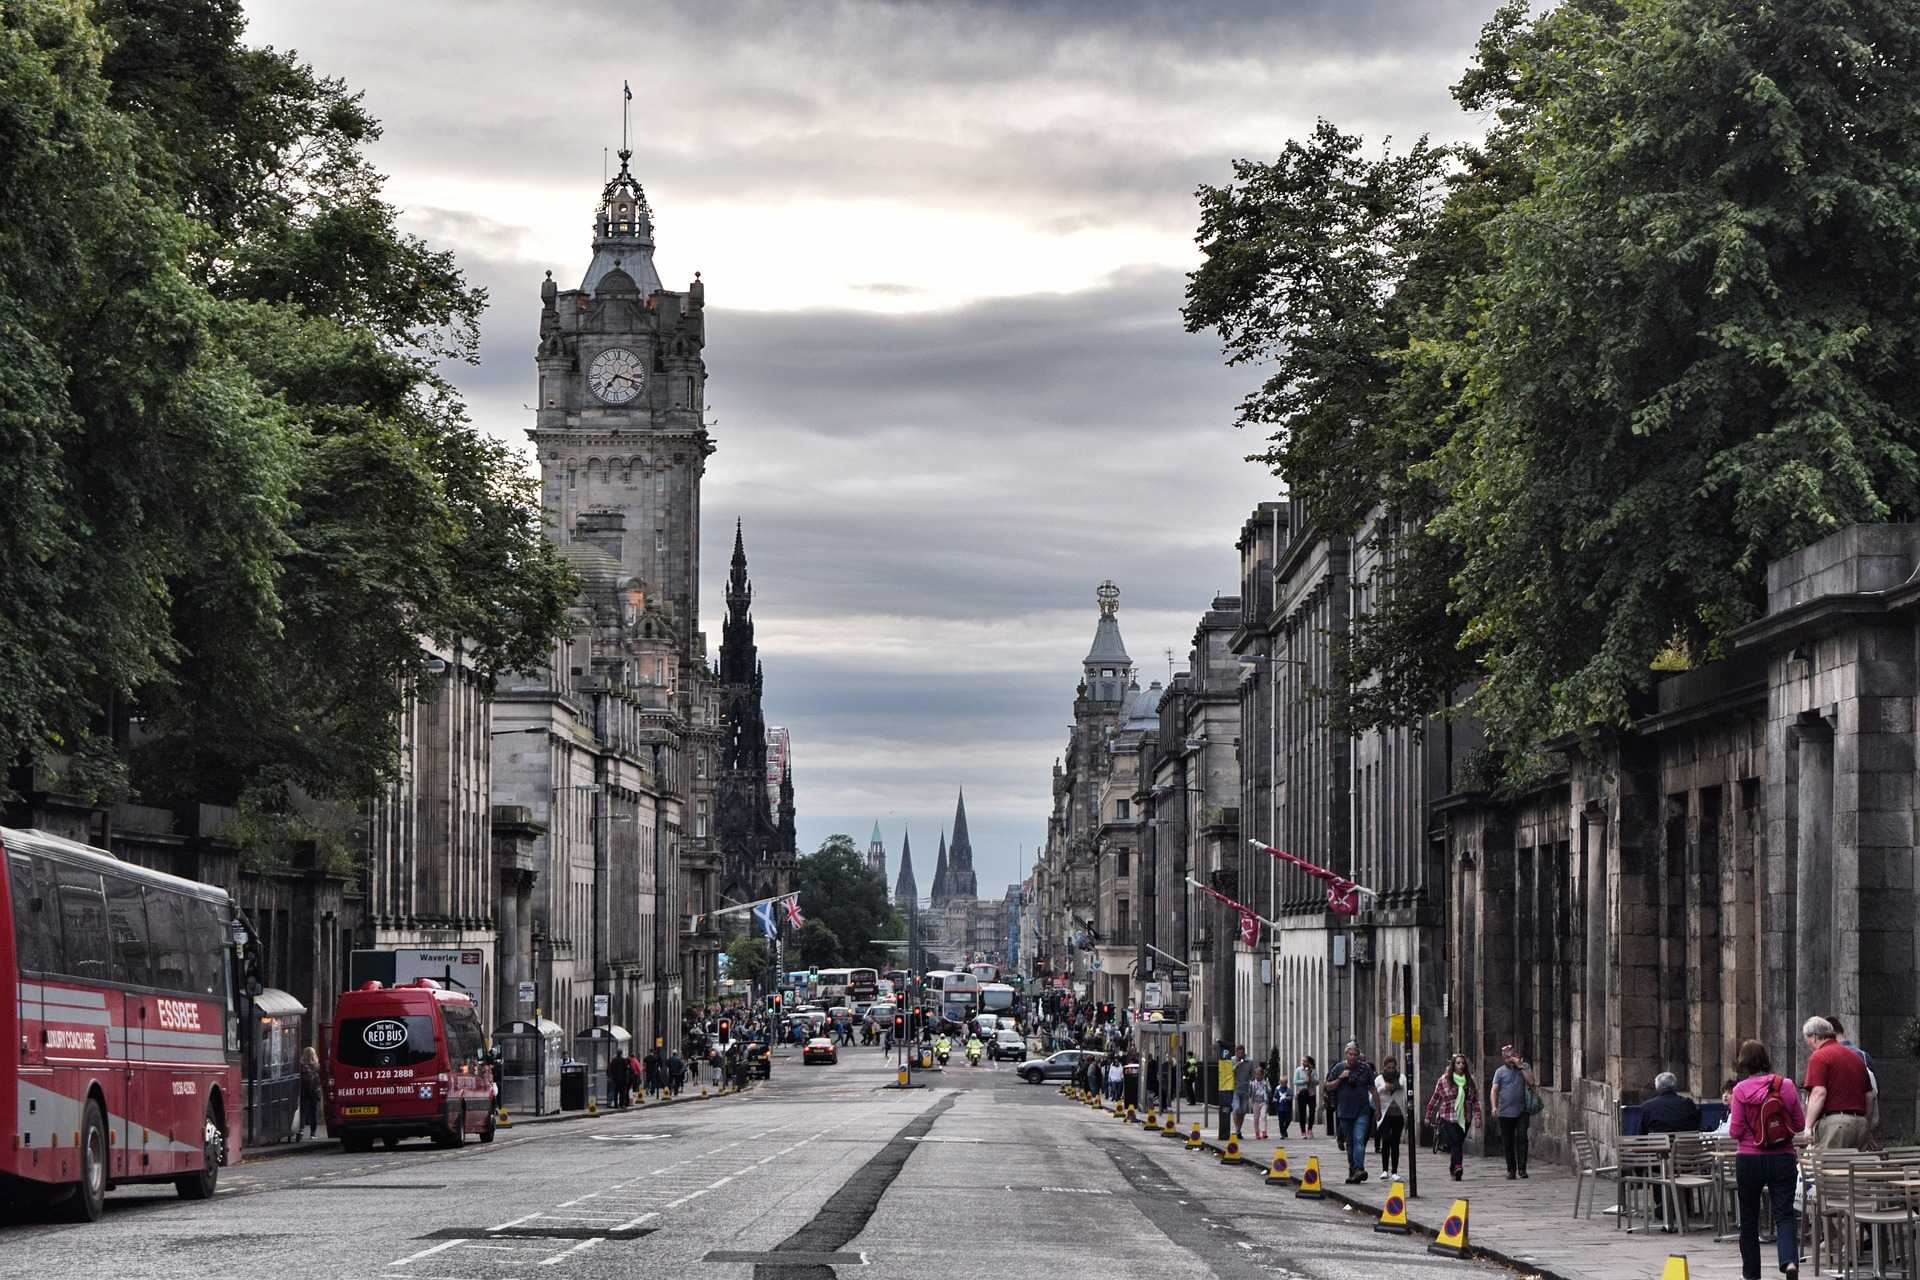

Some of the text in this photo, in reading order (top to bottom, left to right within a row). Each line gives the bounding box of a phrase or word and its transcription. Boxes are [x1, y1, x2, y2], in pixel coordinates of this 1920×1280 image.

[420, 954, 458, 962] Waverley
[157, 999, 200, 1029] ESSBEE
[368, 1030, 402, 1041] RED BUS
[1223, 1049, 1230, 1059] P
[354, 1071, 373, 1079] 0131
[376, 1070, 391, 1079] 228
[338, 1085, 414, 1096] HEART OF SCOTLAND TOURS
